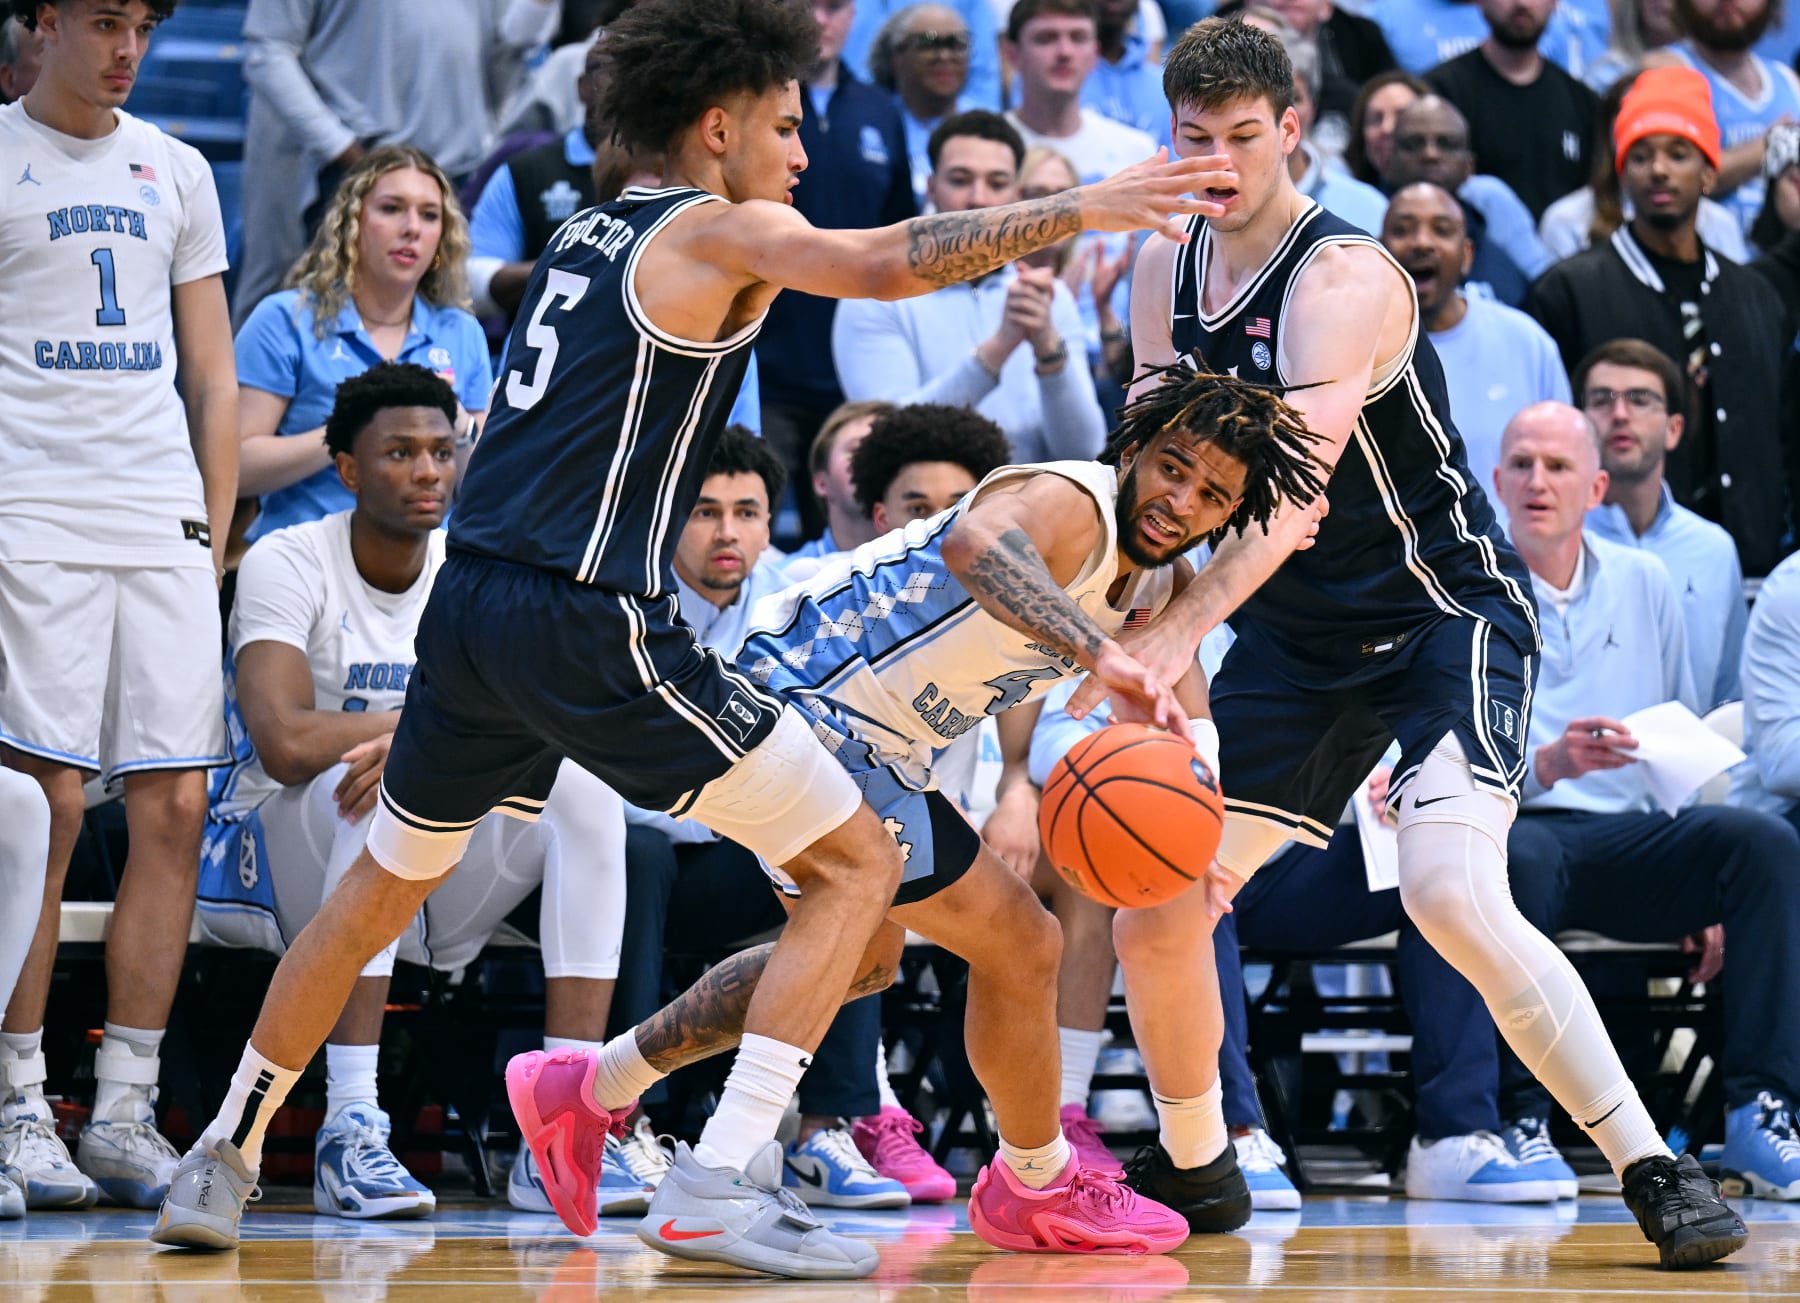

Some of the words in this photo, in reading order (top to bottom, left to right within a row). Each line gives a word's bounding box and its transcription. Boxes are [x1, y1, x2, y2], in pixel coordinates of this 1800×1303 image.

[47, 204, 148, 241] NORTH
[554, 211, 635, 263] PRCTR
[918, 212, 1058, 266] Sacrifice
[91, 247, 126, 327] 1
[34, 340, 162, 371] CAROLINA
[505, 267, 592, 411] 5
[982, 665, 1064, 716] 4
